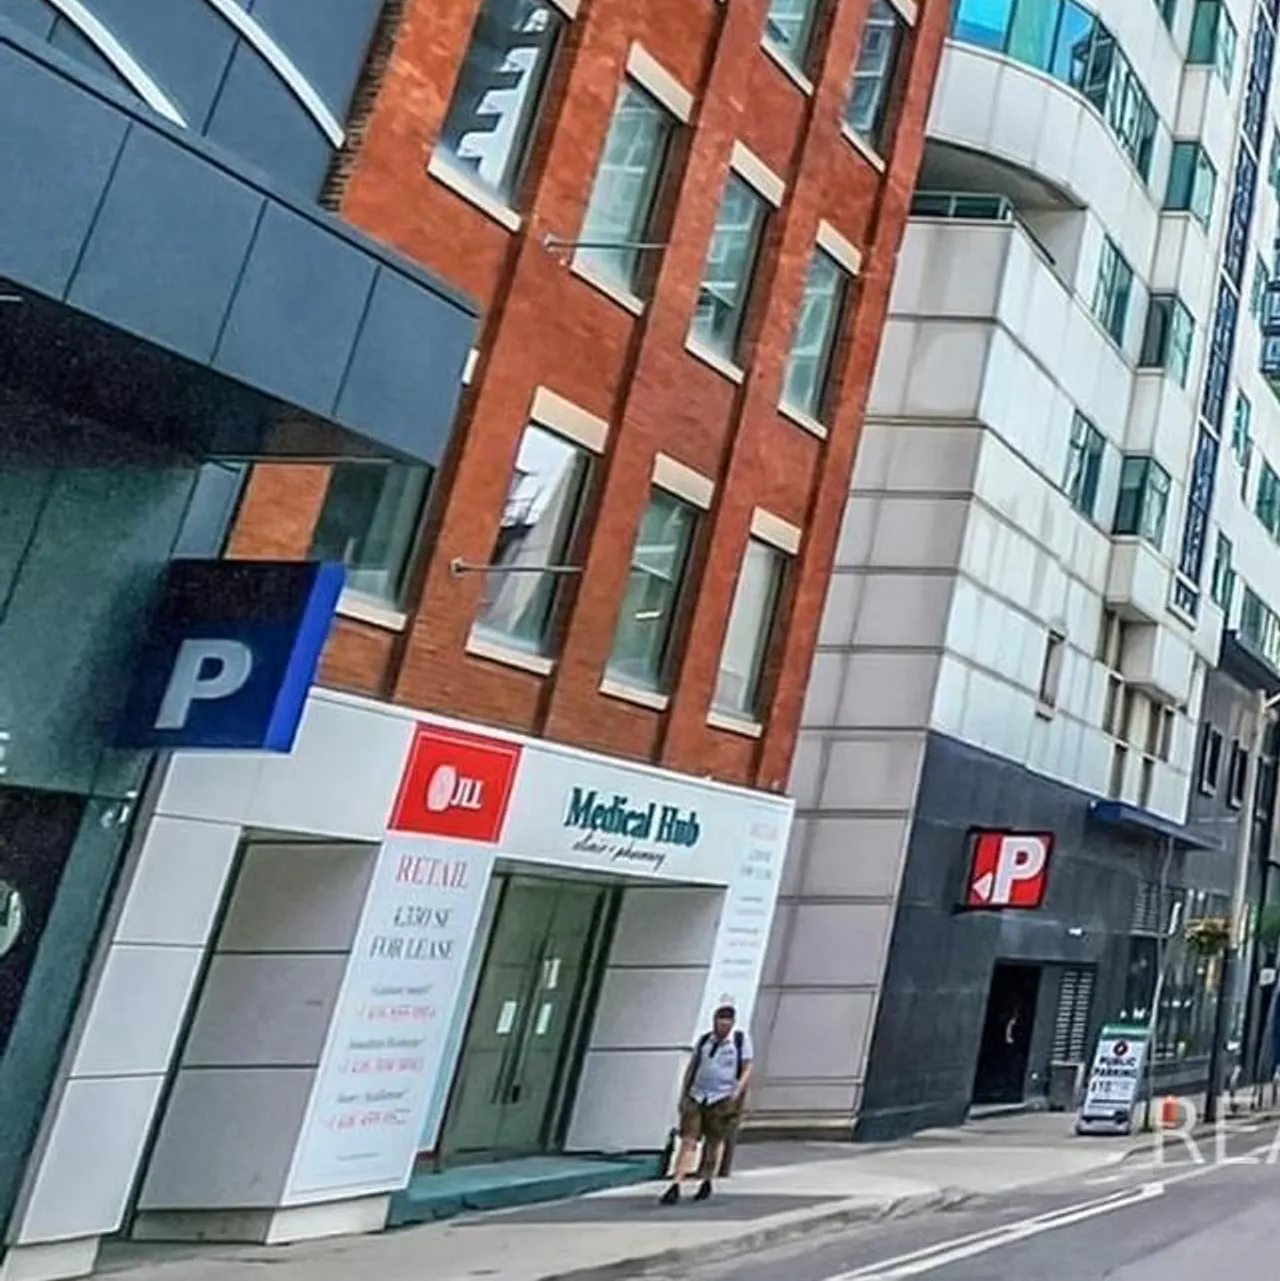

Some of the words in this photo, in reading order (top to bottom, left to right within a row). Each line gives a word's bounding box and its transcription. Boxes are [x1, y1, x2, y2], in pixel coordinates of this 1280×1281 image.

[153, 638, 252, 730] P
[449, 777, 484, 809] JLL
[564, 787, 655, 840] Medical
[655, 805, 700, 848] Hub
[396, 854, 469, 889] RETAIL
[990, 835, 1045, 904] P
